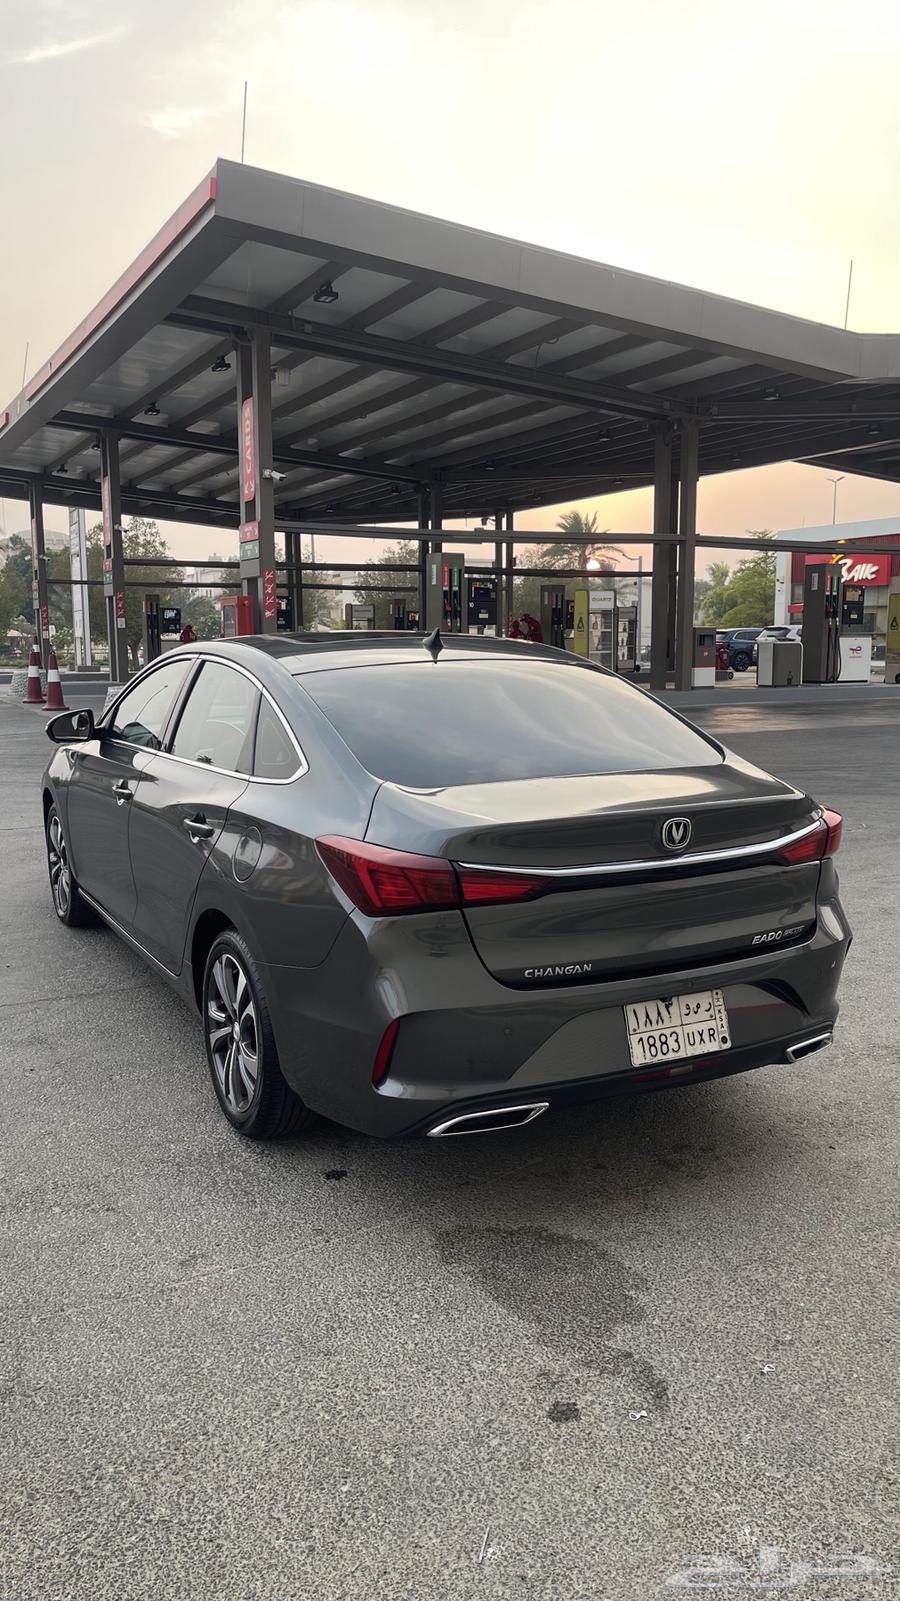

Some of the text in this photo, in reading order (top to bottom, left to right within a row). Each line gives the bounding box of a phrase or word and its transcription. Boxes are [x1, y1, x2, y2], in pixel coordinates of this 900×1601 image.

[751, 930, 783, 945] EADO
[524, 963, 592, 978] CHANGAN
[637, 1027, 717, 1060] 1883 UXR
